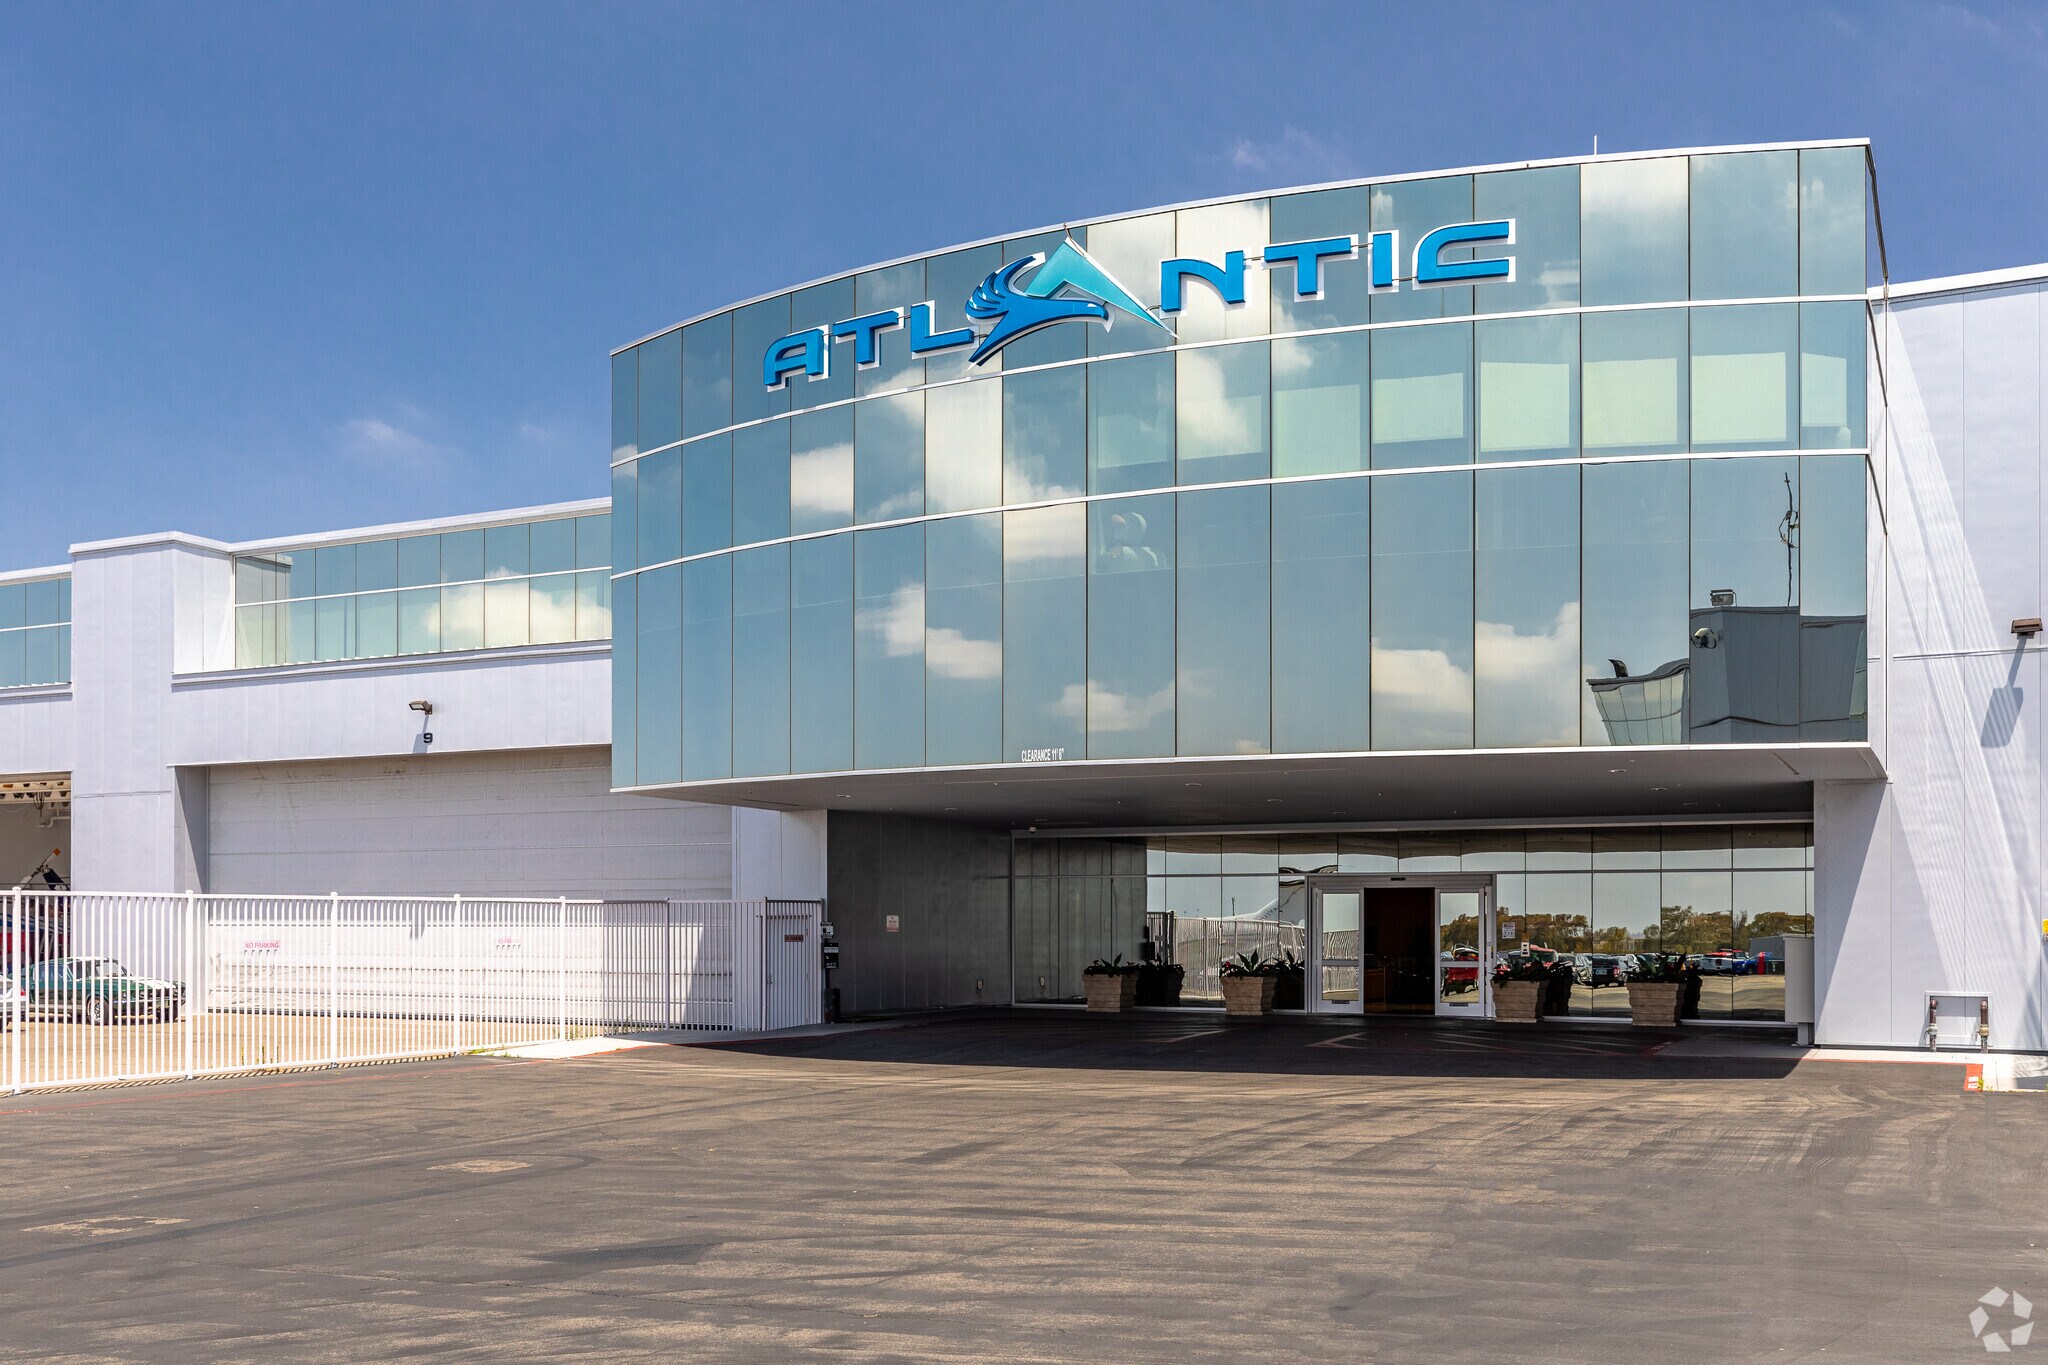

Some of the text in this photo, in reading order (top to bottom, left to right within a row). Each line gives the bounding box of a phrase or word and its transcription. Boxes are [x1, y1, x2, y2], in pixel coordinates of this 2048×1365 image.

[423, 732, 433, 744] 9
[1021, 749, 1051, 762] CLEARANCE
[245, 941, 280, 949] NO PARKING
